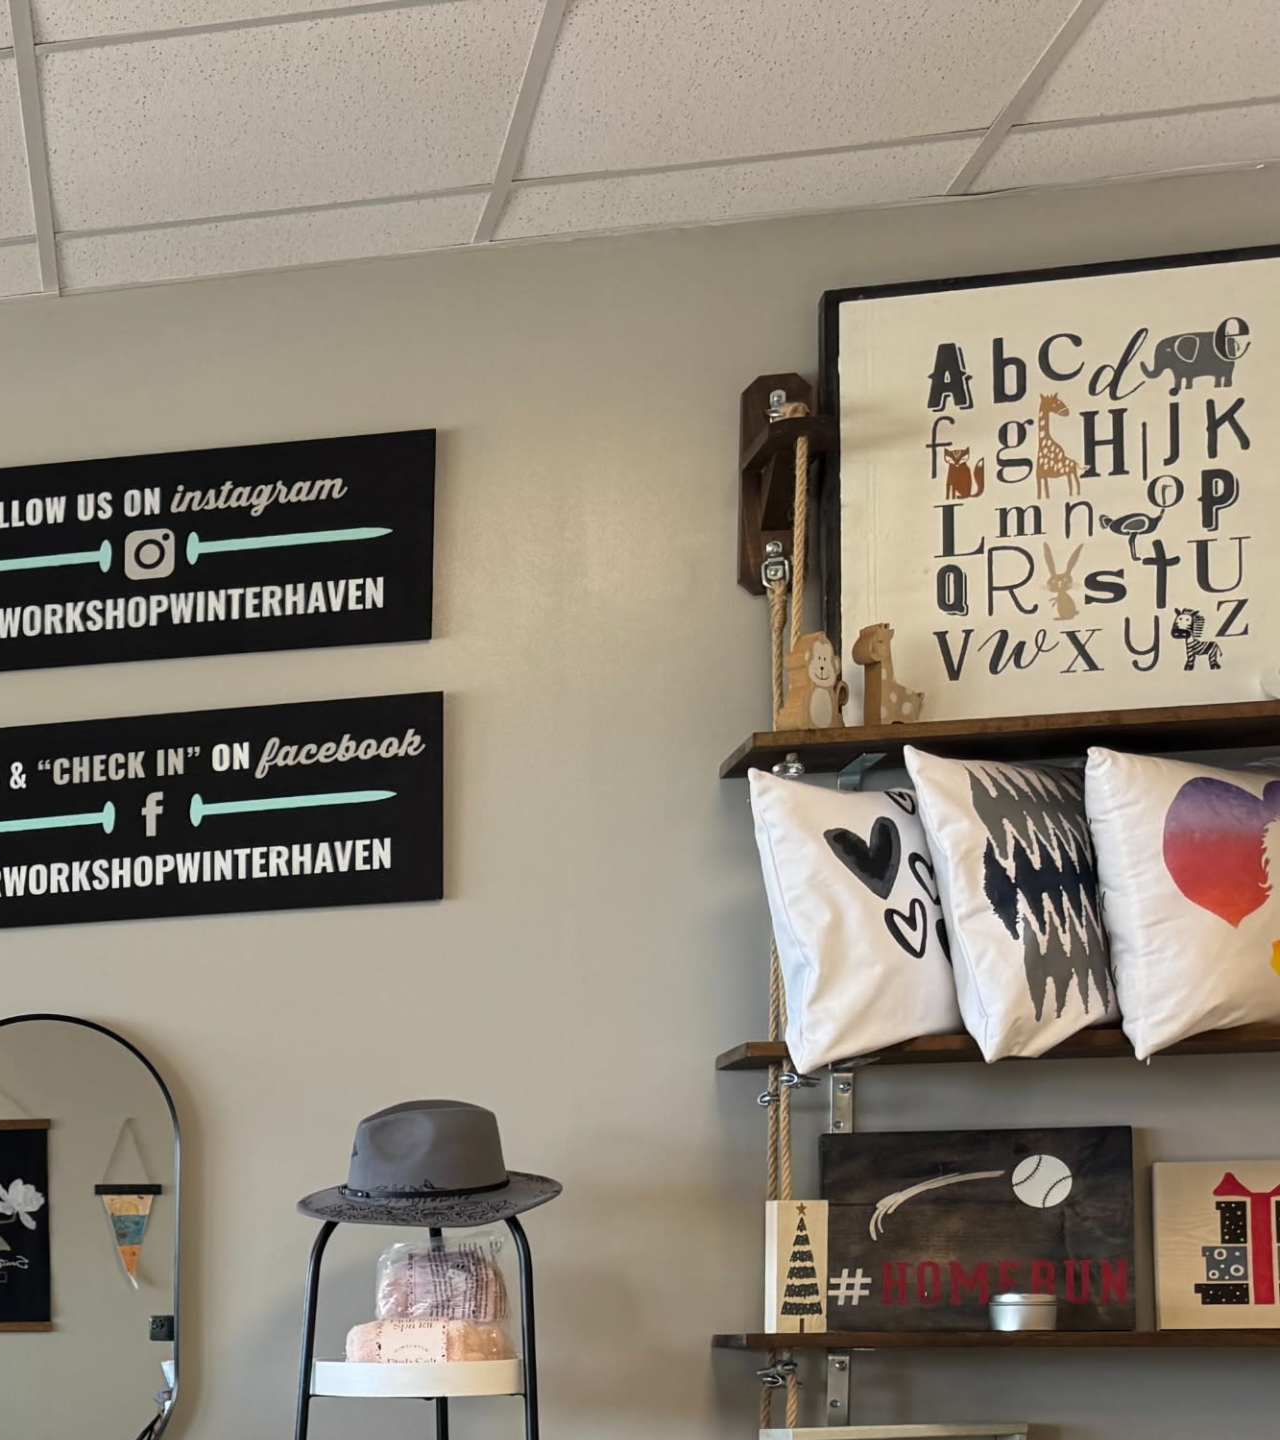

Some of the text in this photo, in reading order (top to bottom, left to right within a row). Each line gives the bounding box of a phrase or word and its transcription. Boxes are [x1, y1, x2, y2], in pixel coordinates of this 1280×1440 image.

[77, 491, 112, 520] US
[124, 488, 160, 517] ON
[170, 477, 348, 517] instagram
[10, 762, 27, 789] &
[212, 742, 250, 771] ON
[255, 729, 425, 778] facebook
